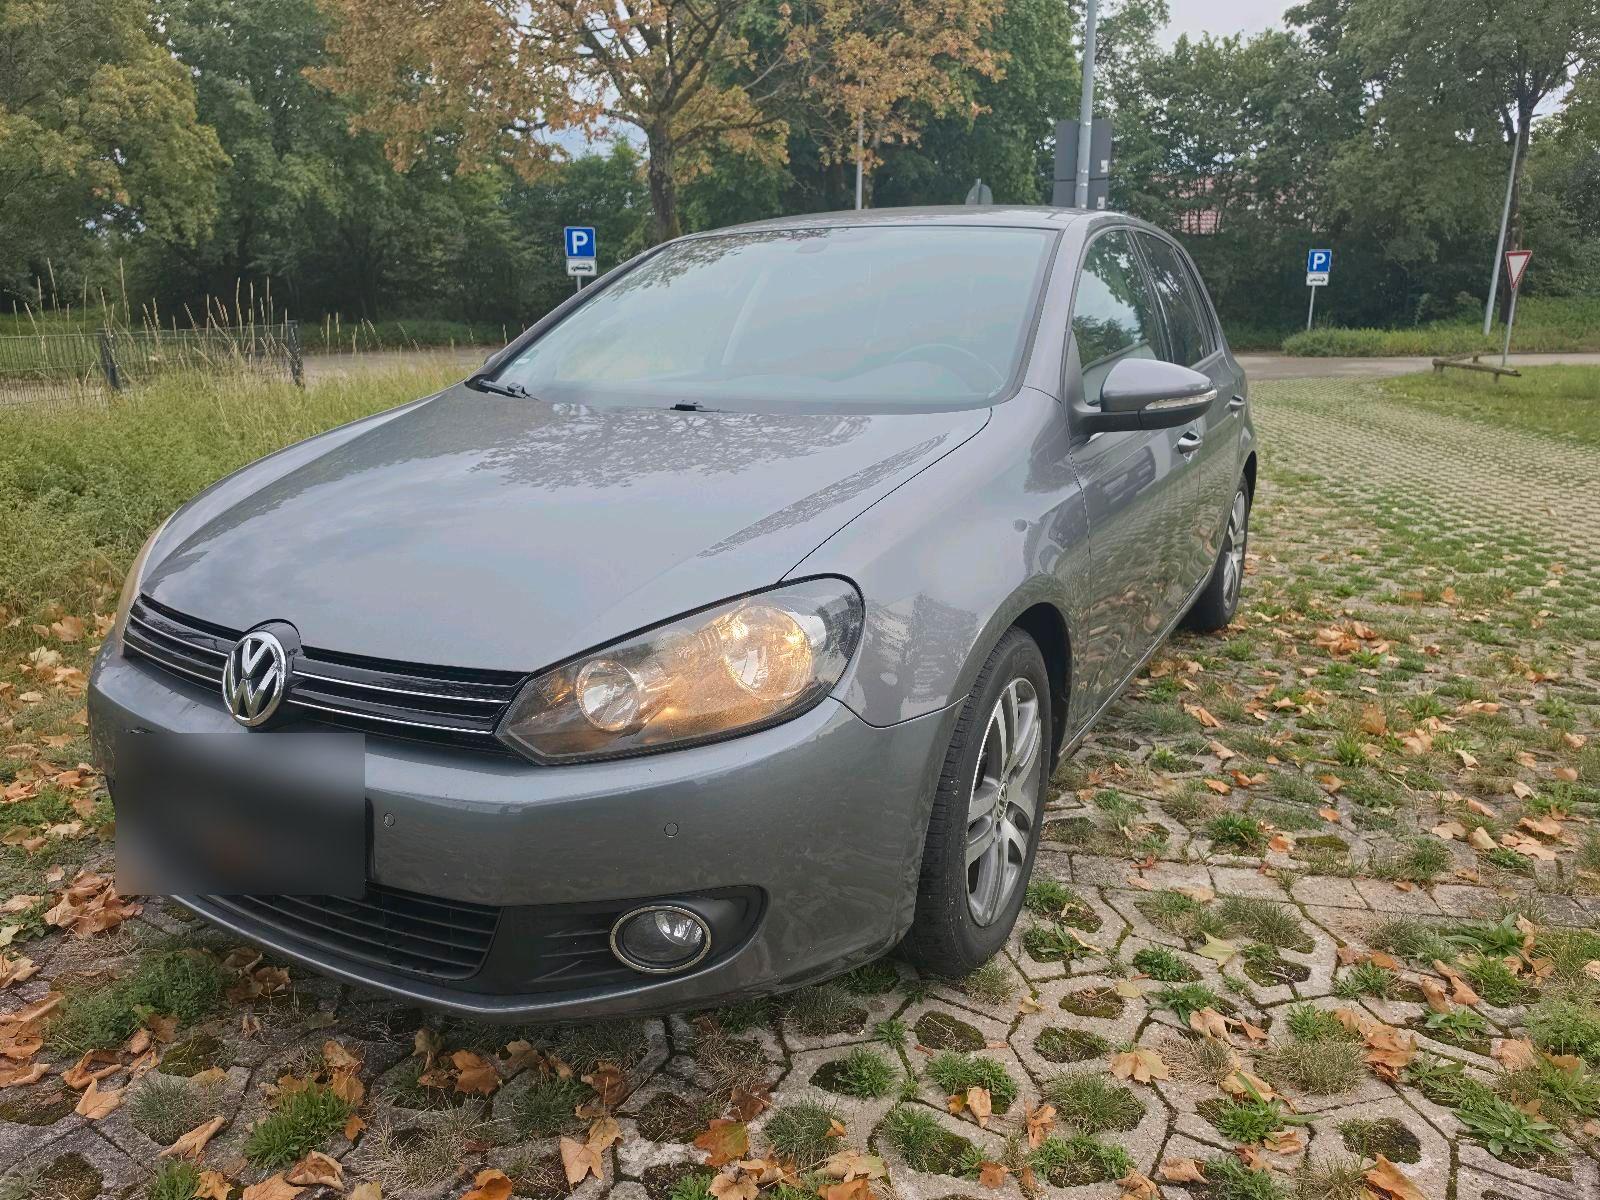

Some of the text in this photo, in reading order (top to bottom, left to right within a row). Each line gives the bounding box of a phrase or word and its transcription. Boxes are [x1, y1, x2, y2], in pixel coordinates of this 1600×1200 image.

[572, 231, 588, 254] P
[1313, 253, 1326, 270] P
[228, 637, 283, 720] VW
